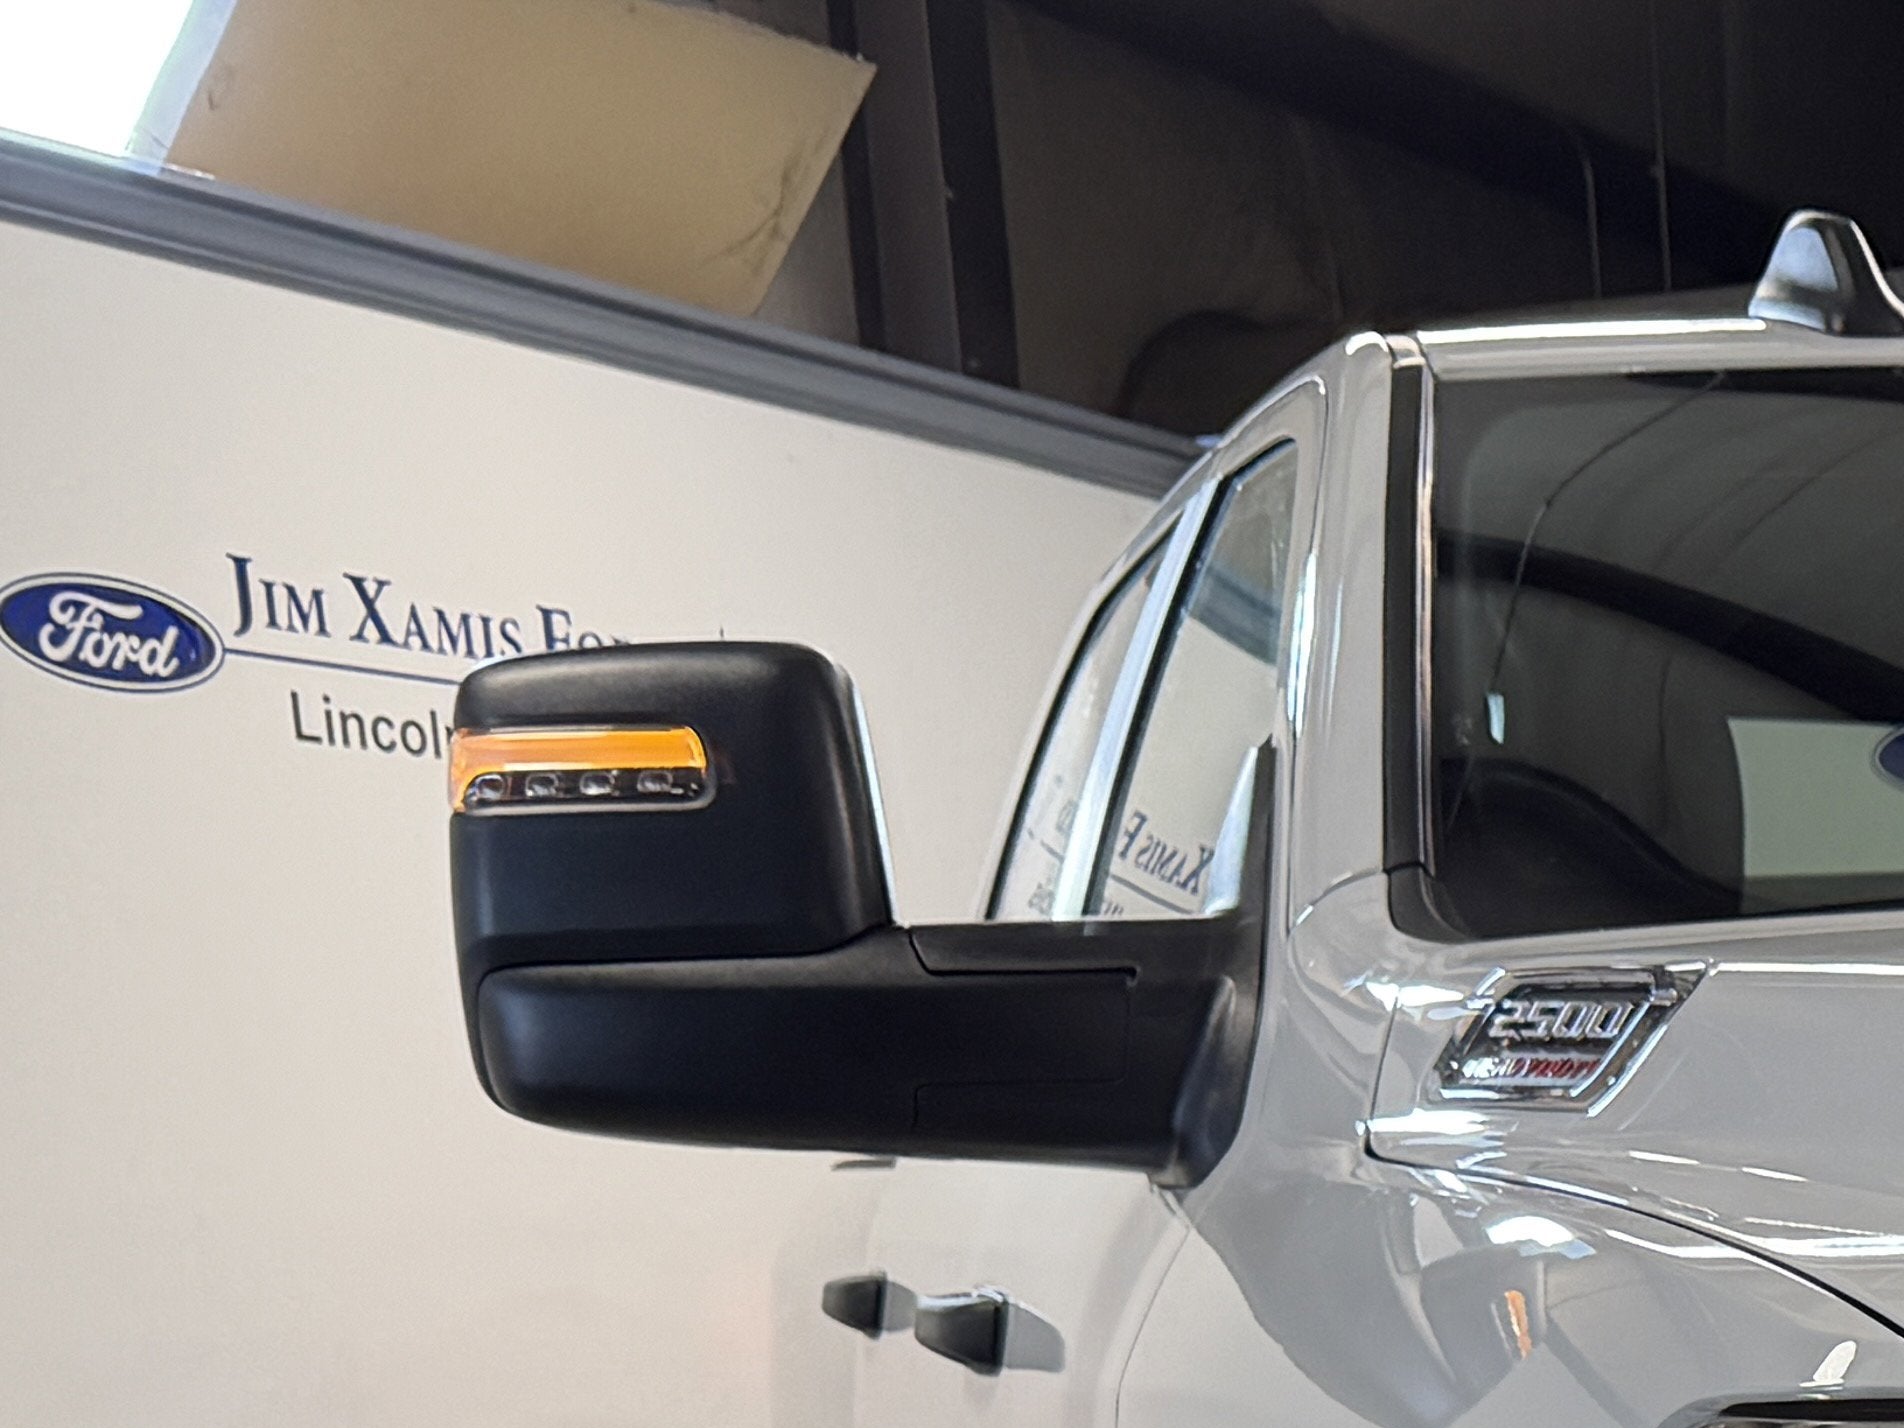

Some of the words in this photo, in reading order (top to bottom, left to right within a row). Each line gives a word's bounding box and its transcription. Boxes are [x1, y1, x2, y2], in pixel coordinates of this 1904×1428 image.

[38, 591, 180, 678] Ford
[290, 689, 455, 758] Lincol
[1487, 999, 1636, 1042] 2500
